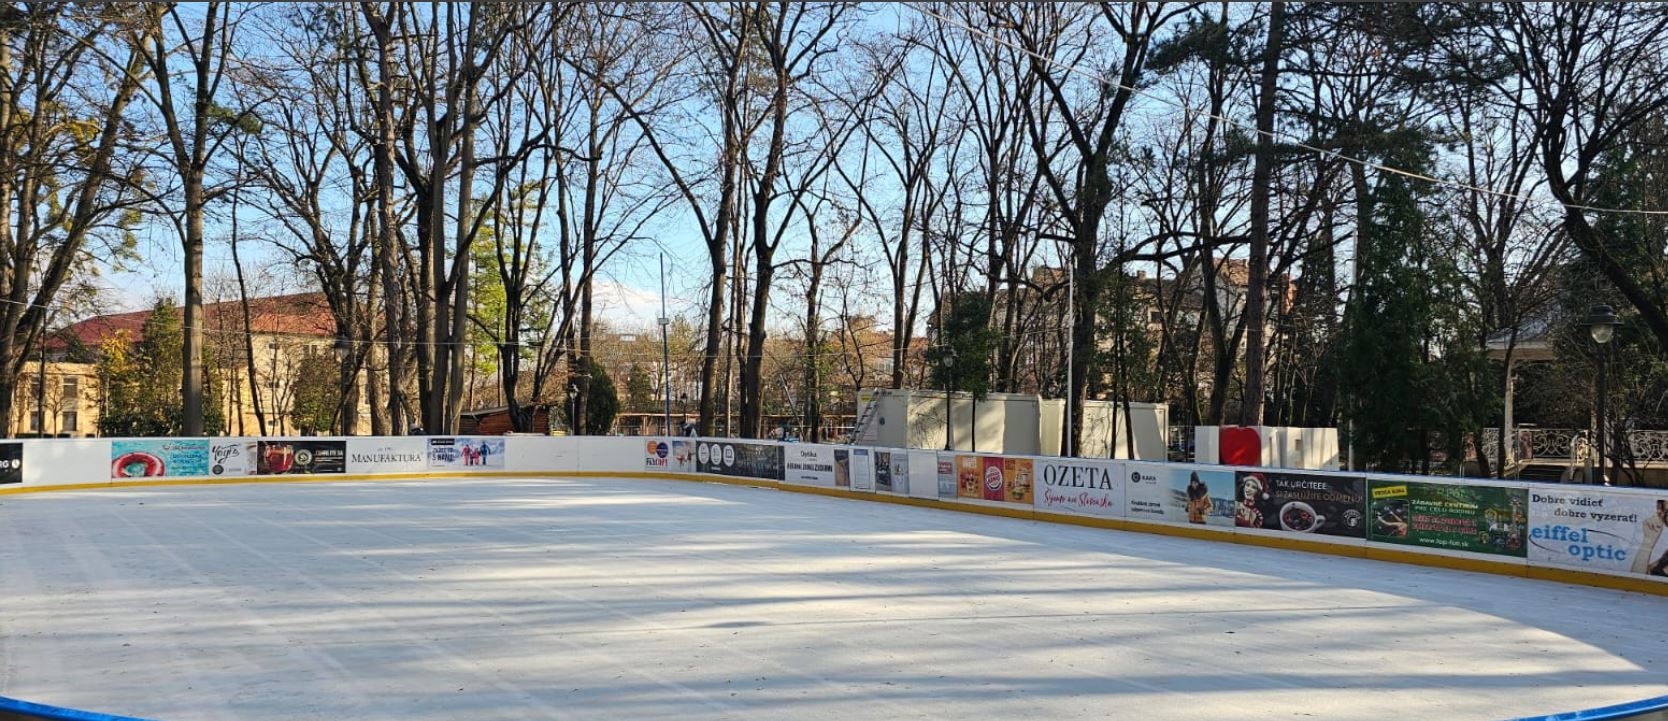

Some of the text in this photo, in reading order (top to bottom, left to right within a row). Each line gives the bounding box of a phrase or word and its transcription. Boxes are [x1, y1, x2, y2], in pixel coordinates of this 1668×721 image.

[351, 453, 422, 463] MANUFAKTURA
[1043, 464, 1113, 490] OZETA
[1532, 493, 1603, 508] Dobre vidieť
[1554, 507, 1638, 523] dobre vyzerať!
[1531, 524, 1588, 543] eiffel
[1568, 544, 1627, 561] optic
